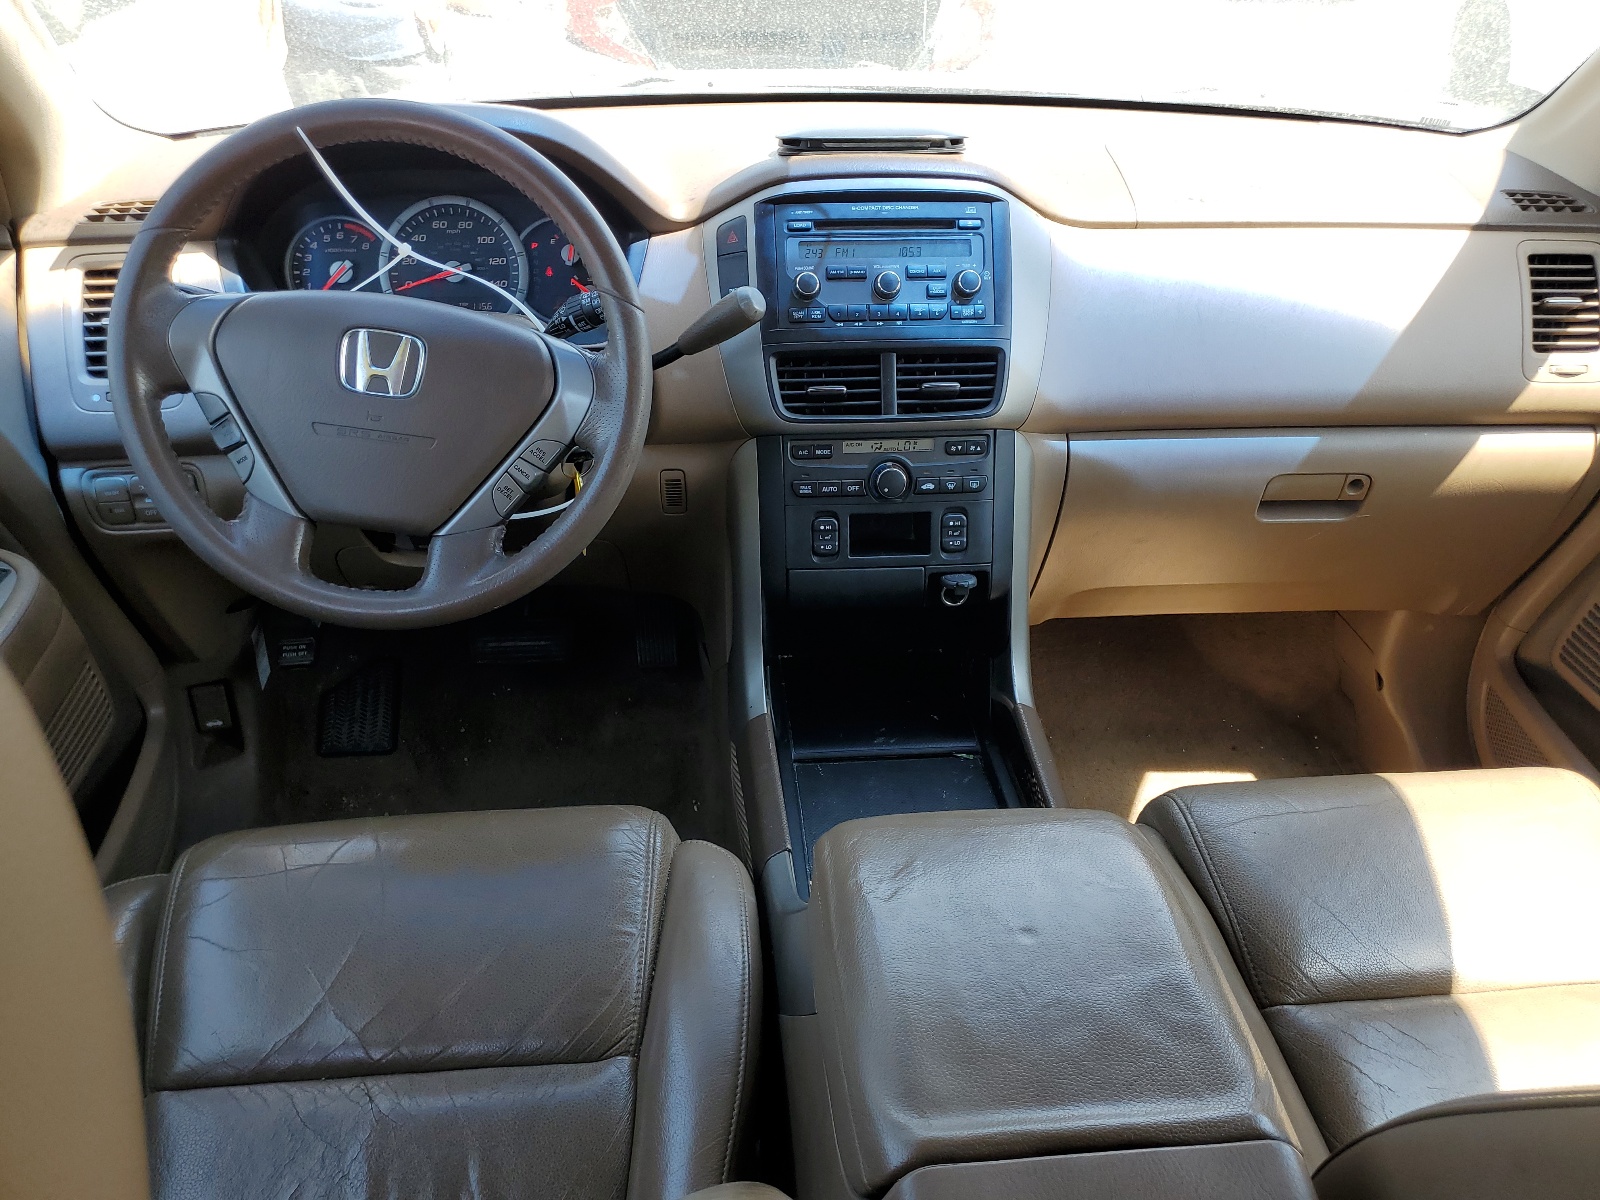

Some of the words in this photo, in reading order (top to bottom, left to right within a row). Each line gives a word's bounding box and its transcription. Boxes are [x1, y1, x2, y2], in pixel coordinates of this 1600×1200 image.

[432, 220, 447, 229] 60
[458, 221, 473, 229] 80
[323, 234, 331, 243] 5
[336, 231, 344, 239] 6
[350, 235, 358, 244] 7
[411, 234, 427, 242] 40
[476, 236, 495, 244] 100
[309, 241, 318, 250] 4
[361, 242, 370, 250] 8
[304, 254, 312, 262] 3
[401, 256, 417, 265] 20
[488, 257, 507, 265] 120
[302, 268, 311, 276] 2
[307, 282, 312, 290] 1
[536, 446, 546, 457] RES
[236, 455, 248, 465] MODE
[529, 449, 545, 464] ACCEL
[513, 464, 531, 481] CANCEL
[496, 486, 513, 501] DECEL
[503, 485, 514, 495] SET
